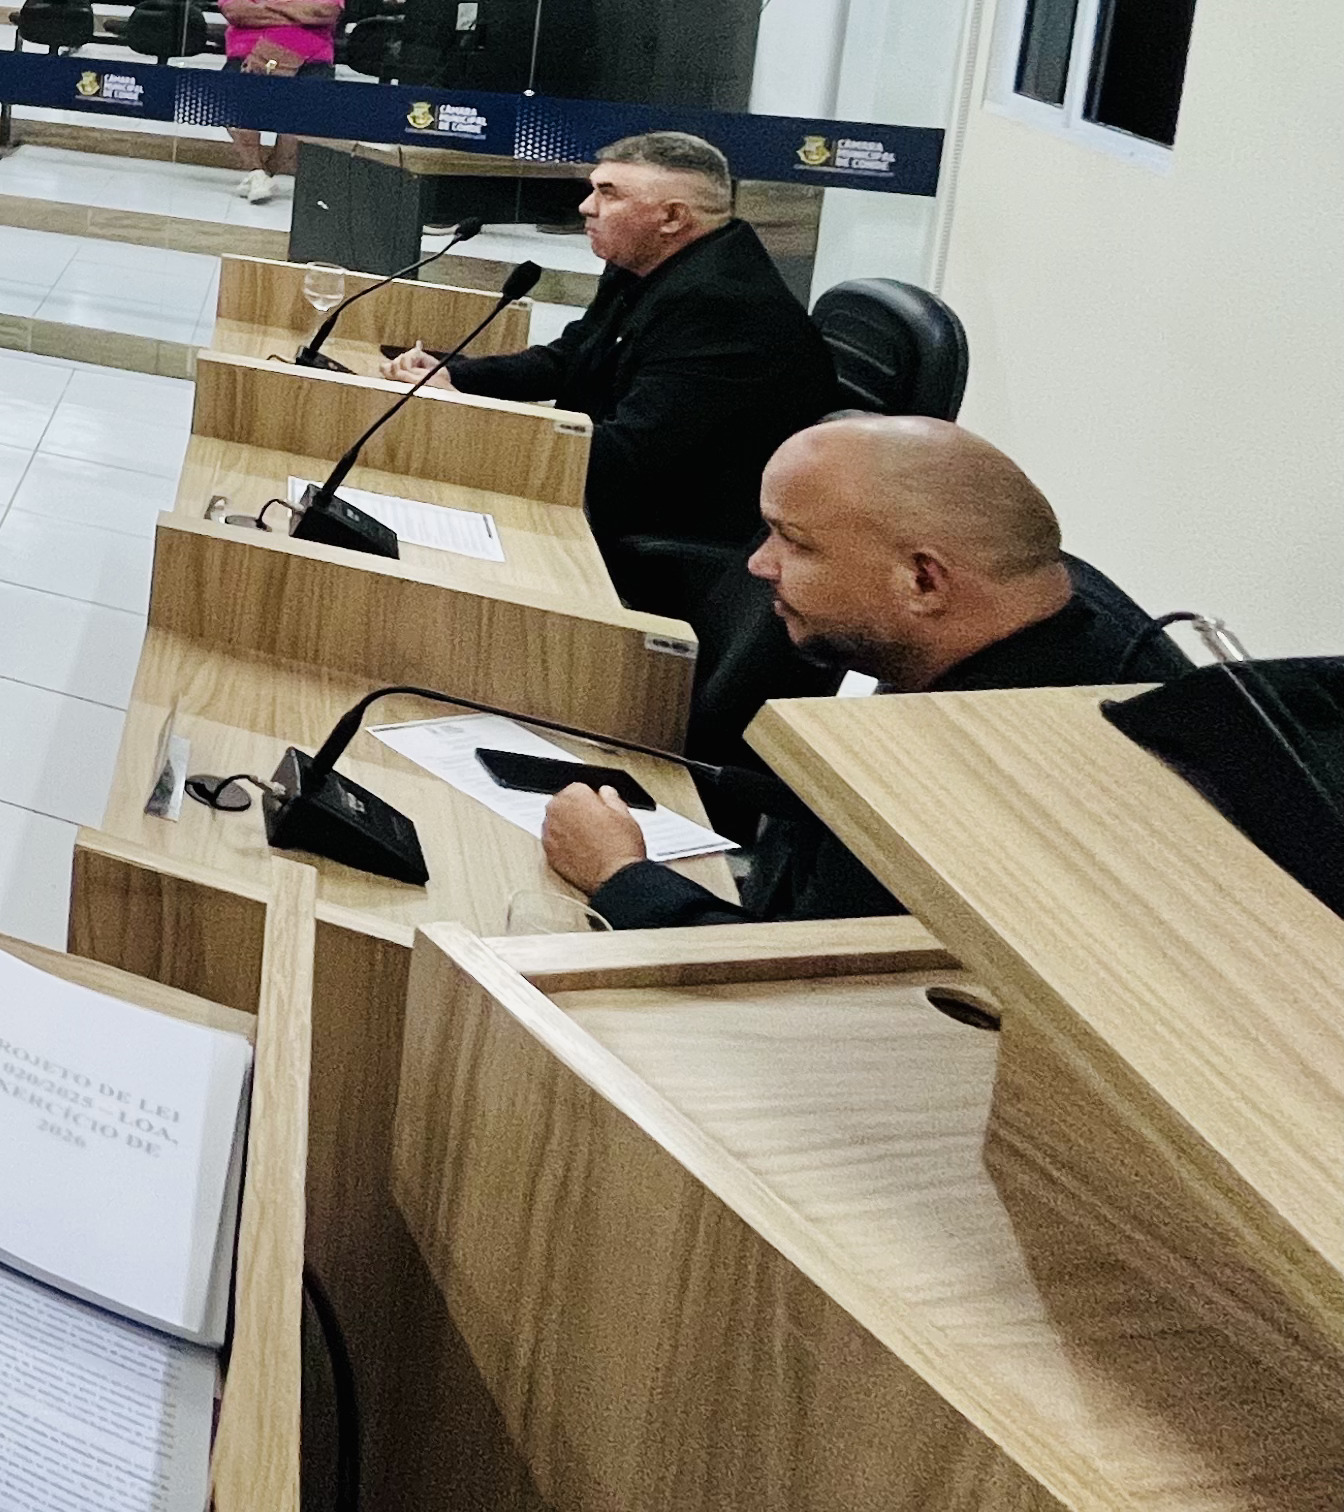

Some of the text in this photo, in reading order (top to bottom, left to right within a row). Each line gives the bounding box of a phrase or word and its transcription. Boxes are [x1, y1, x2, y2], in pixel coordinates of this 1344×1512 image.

[98, 1082, 132, 1105] DE
[138, 1098, 180, 1123] LEI
[36, 1118, 87, 1149] 2026
[125, 1133, 162, 1158] DE
